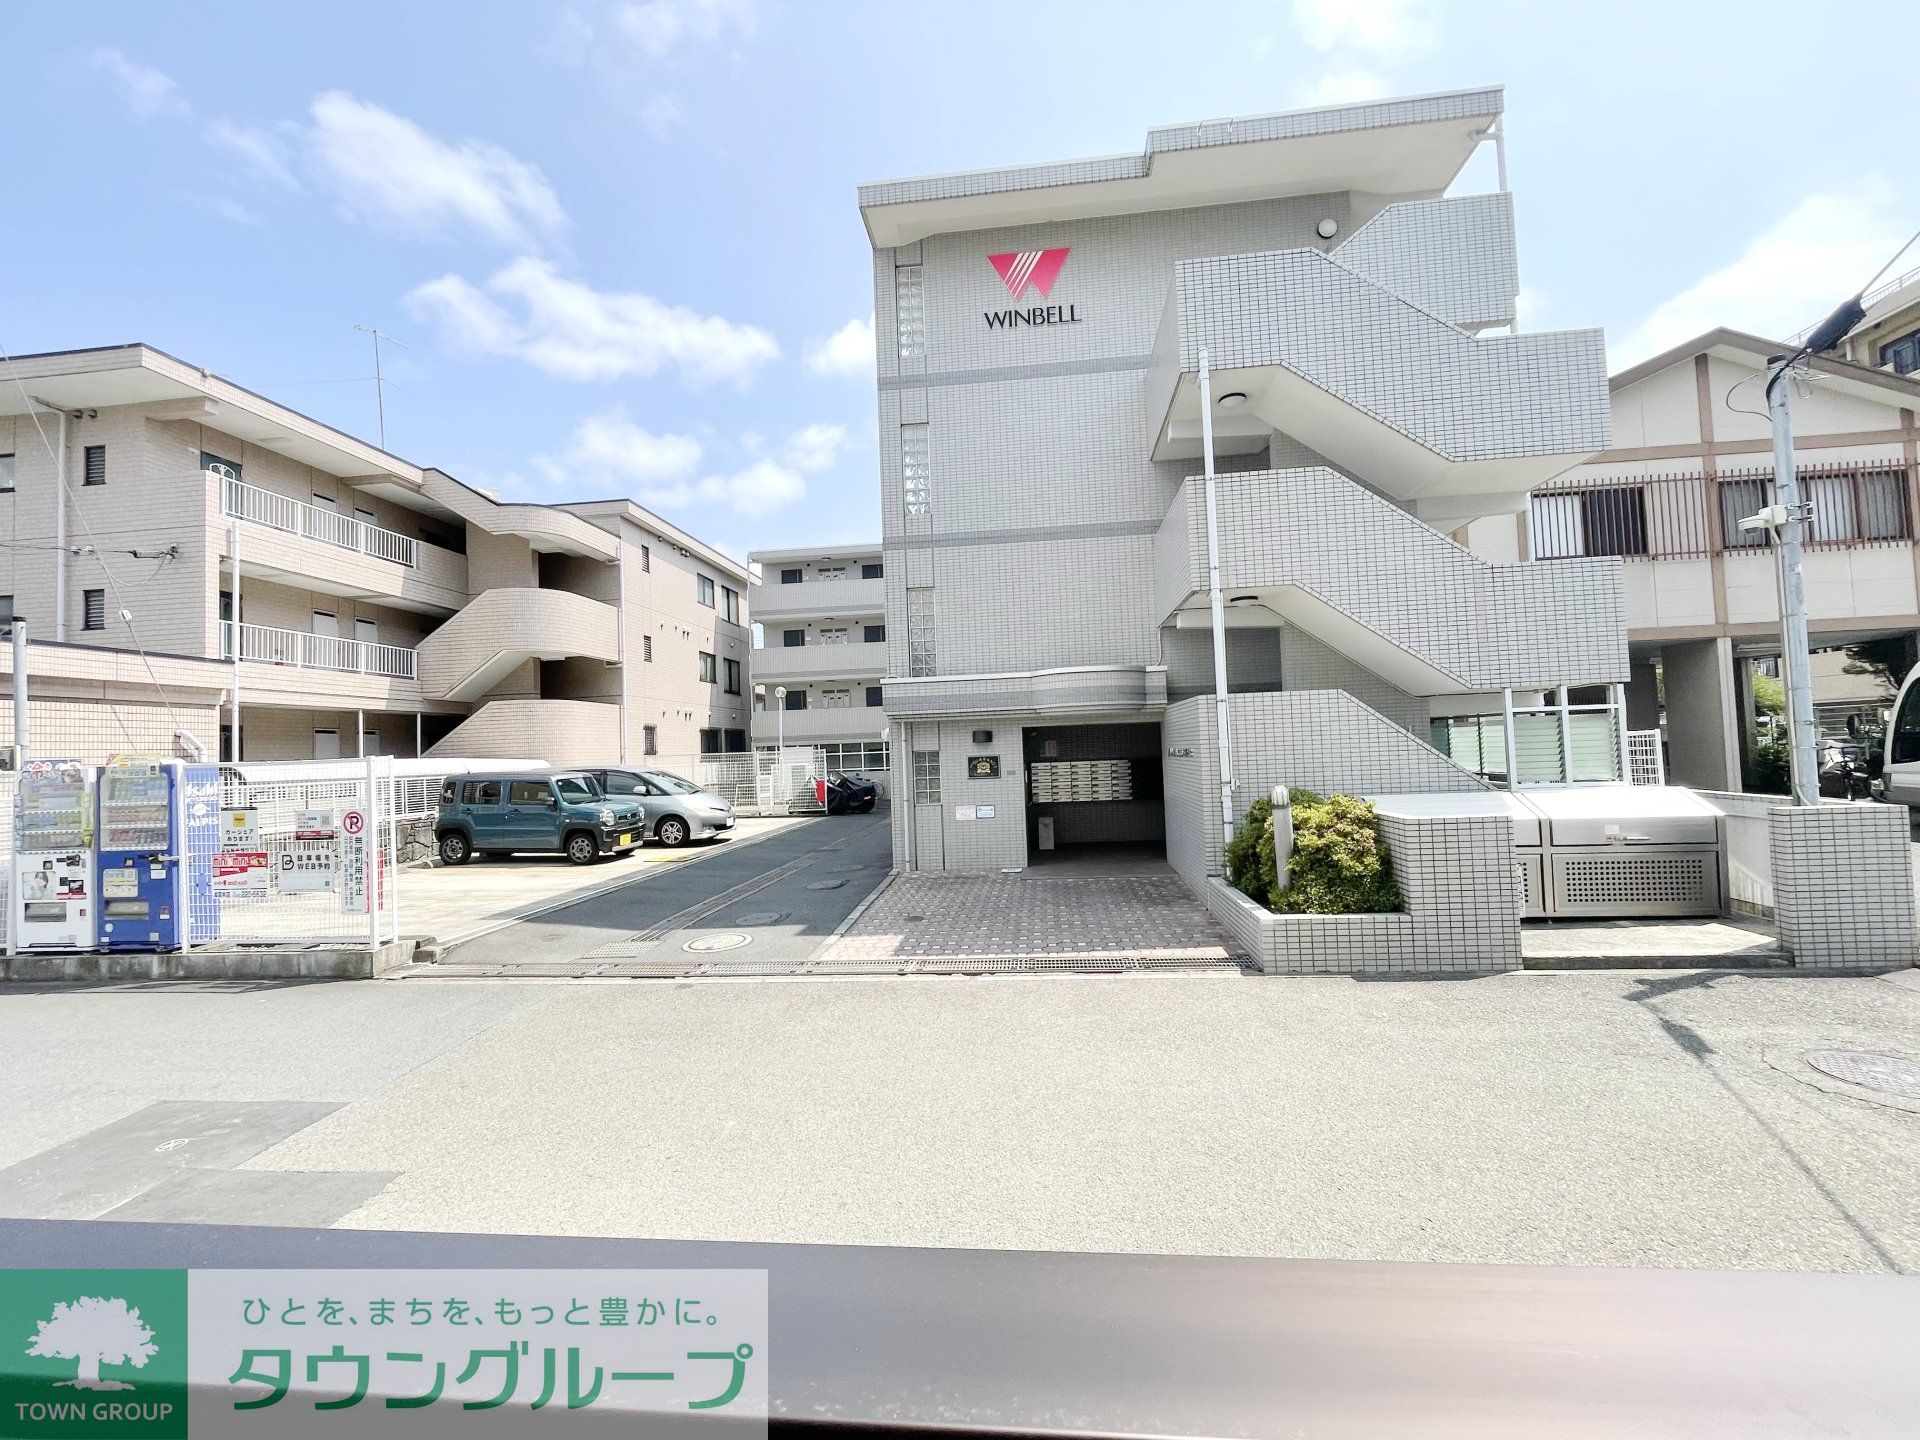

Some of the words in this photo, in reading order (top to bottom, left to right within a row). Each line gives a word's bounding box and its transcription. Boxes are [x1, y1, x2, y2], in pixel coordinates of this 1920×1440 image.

[983, 304, 1082, 330] WINBELL
[354, 837, 363, 896] 無断利用禁止
